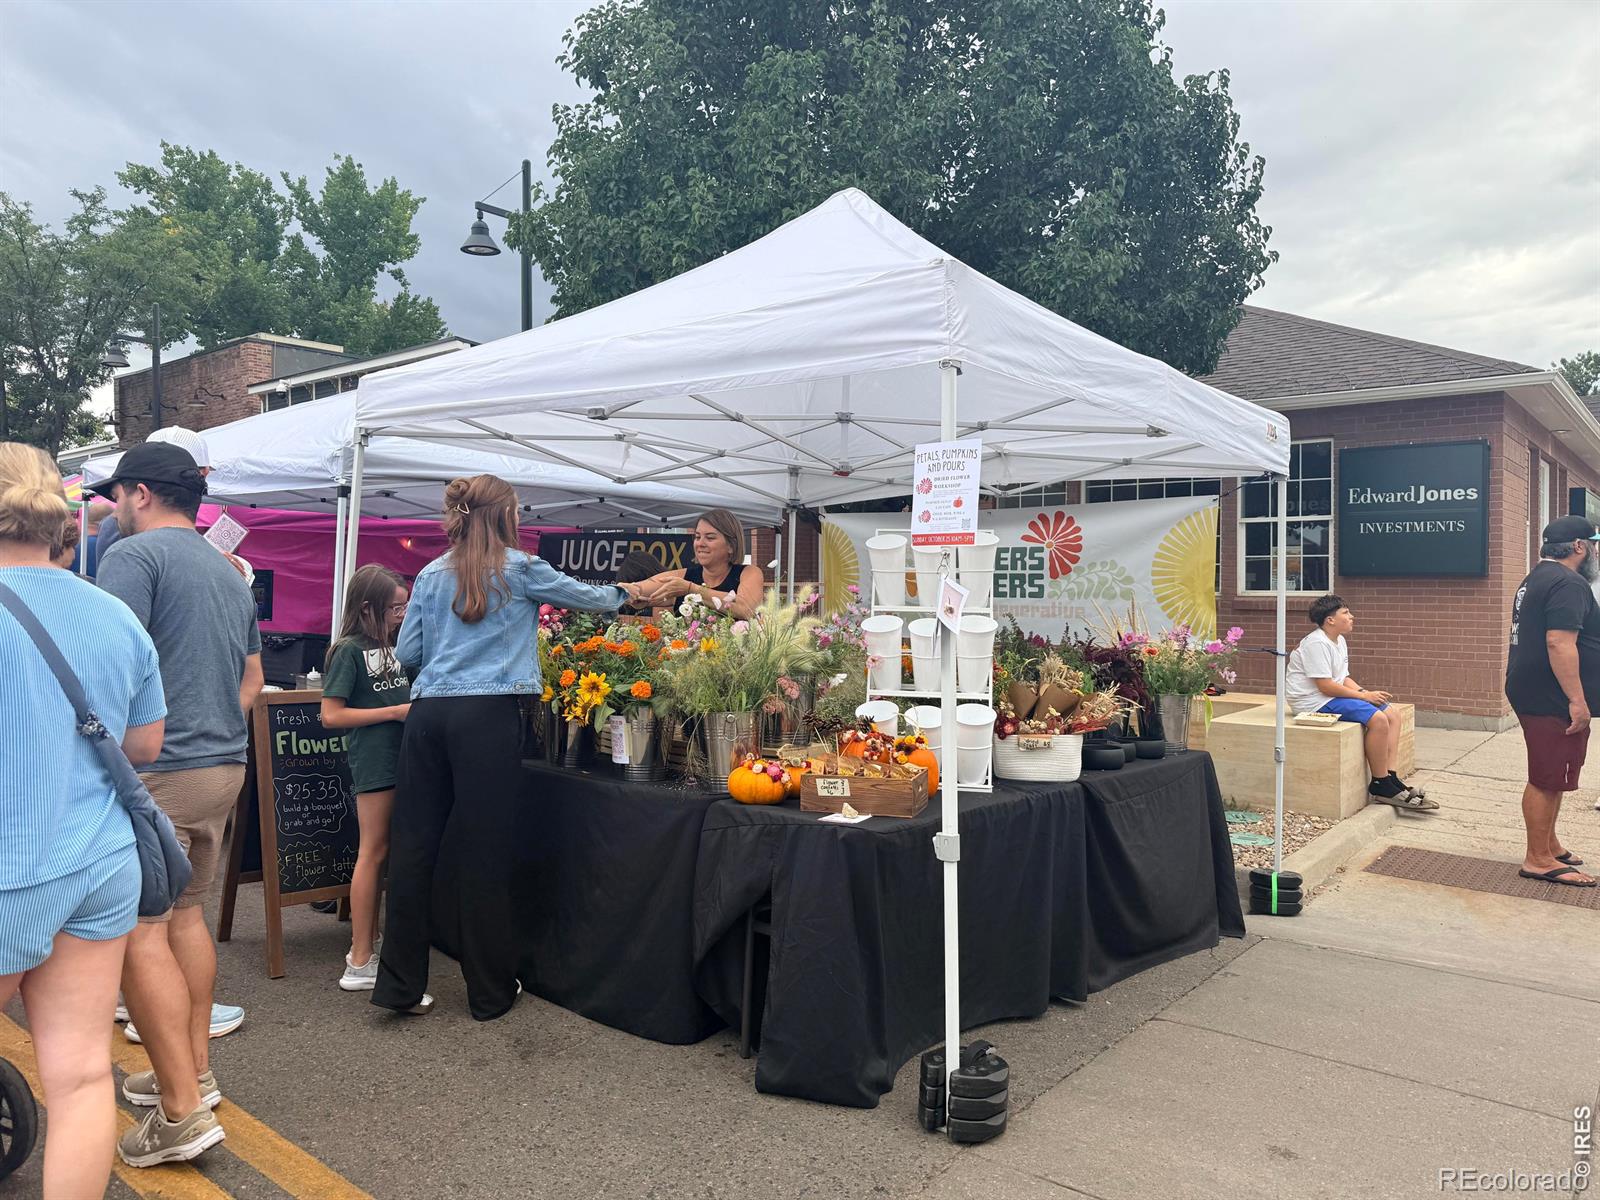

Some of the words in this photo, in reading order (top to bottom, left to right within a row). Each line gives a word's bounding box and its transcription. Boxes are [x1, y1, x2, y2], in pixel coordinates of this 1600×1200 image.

[942, 448, 978, 460] PUMPKINS
[927, 462, 941, 473] AND
[942, 461, 965, 472] POURS
[1359, 520, 1465, 534] INVESTMENTS
[275, 708, 311, 726] fresh
[322, 754, 336, 770] by
[284, 780, 338, 800] $25-35
[282, 803, 301, 813] build
[311, 801, 343, 814] bouquet
[284, 819, 303, 831] grab
[306, 815, 320, 826] and
[321, 814, 335, 827] go!
[285, 850, 321, 867] FREE
[295, 864, 327, 878] flower
